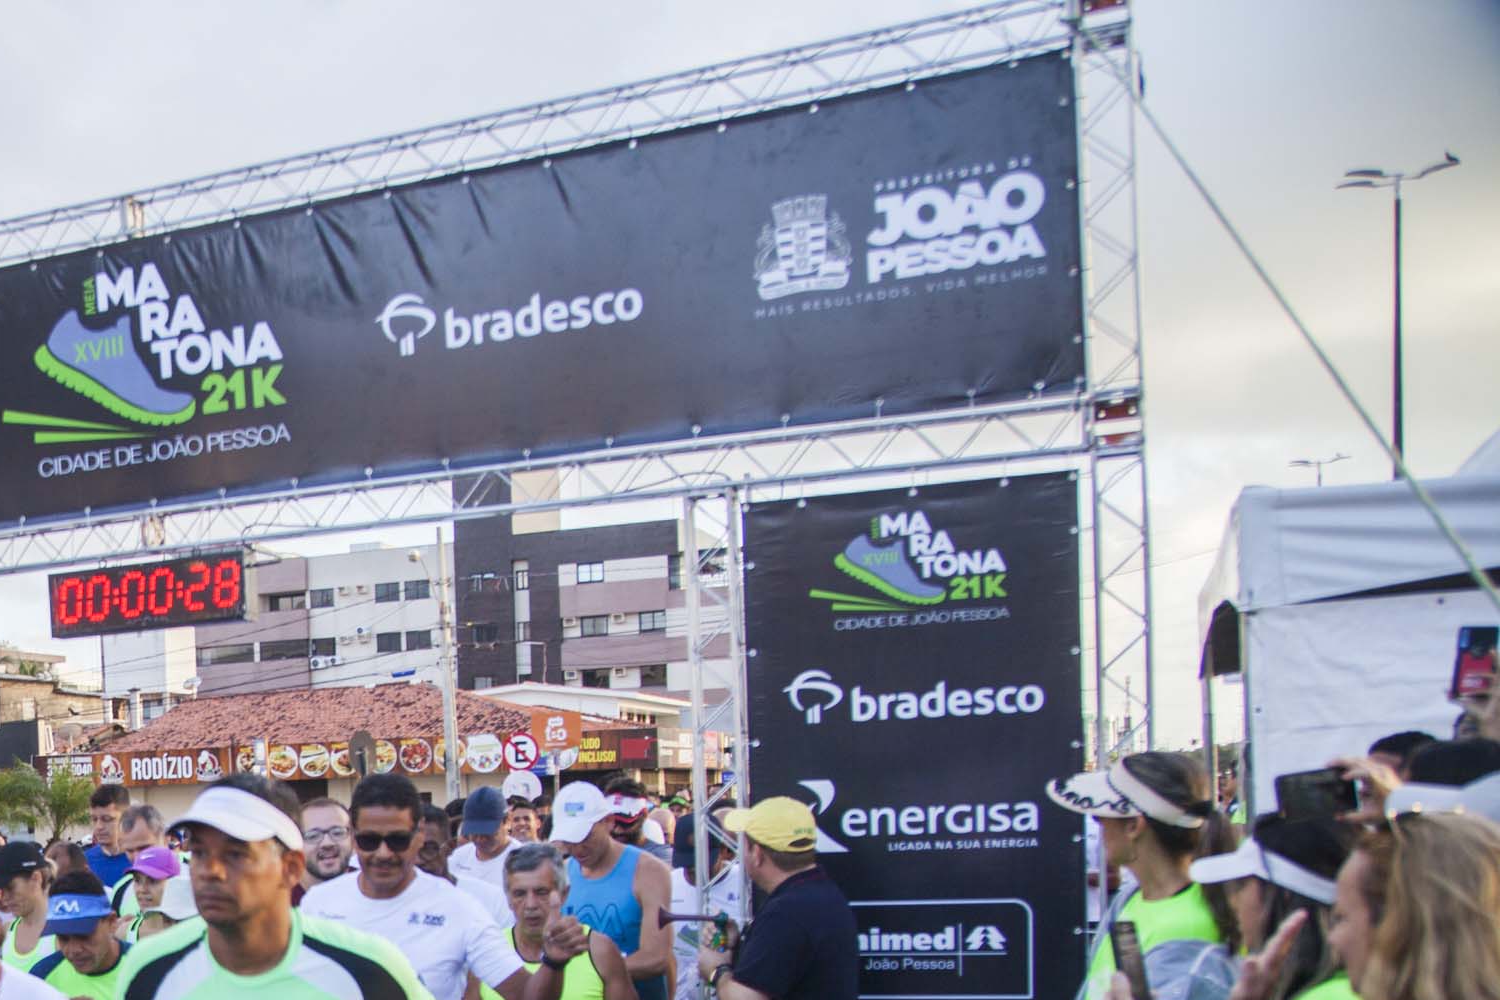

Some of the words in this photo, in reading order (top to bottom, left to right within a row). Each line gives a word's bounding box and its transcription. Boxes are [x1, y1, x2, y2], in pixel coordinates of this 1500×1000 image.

[866, 223, 1046, 283] PESSOA
[83, 276, 97, 316] MEIA
[755, 304, 795, 320] MAIS
[925, 278, 967, 294] VIDA
[974, 265, 1048, 285] MELHOR
[444, 288, 643, 349] bradesco
[73, 335, 124, 364] XVIII
[38, 450, 111, 477] CIDADE
[115, 444, 143, 465] DE
[146, 434, 203, 463] JOÃO
[205, 422, 291, 454] PESSOA
[58, 559, 241, 625] 00:00:28
[834, 616, 886, 631] CIDADE
[889, 615, 908, 626] DE
[910, 610, 950, 625] JOÃO
[952, 607, 1010, 621] PESSOA
[851, 681, 1044, 722] bradesco
[131, 754, 193, 780] RODÍZIO
[578, 751, 616, 763] INCLUSO!
[888, 840, 932, 852] LIGADA
[935, 840, 953, 851] NA
[956, 839, 981, 850] SUA
[984, 837, 1038, 849] ENERGIA
[857, 926, 955, 951] nimed
[865, 957, 899, 971] João
[903, 957, 955, 970] Pessoa
